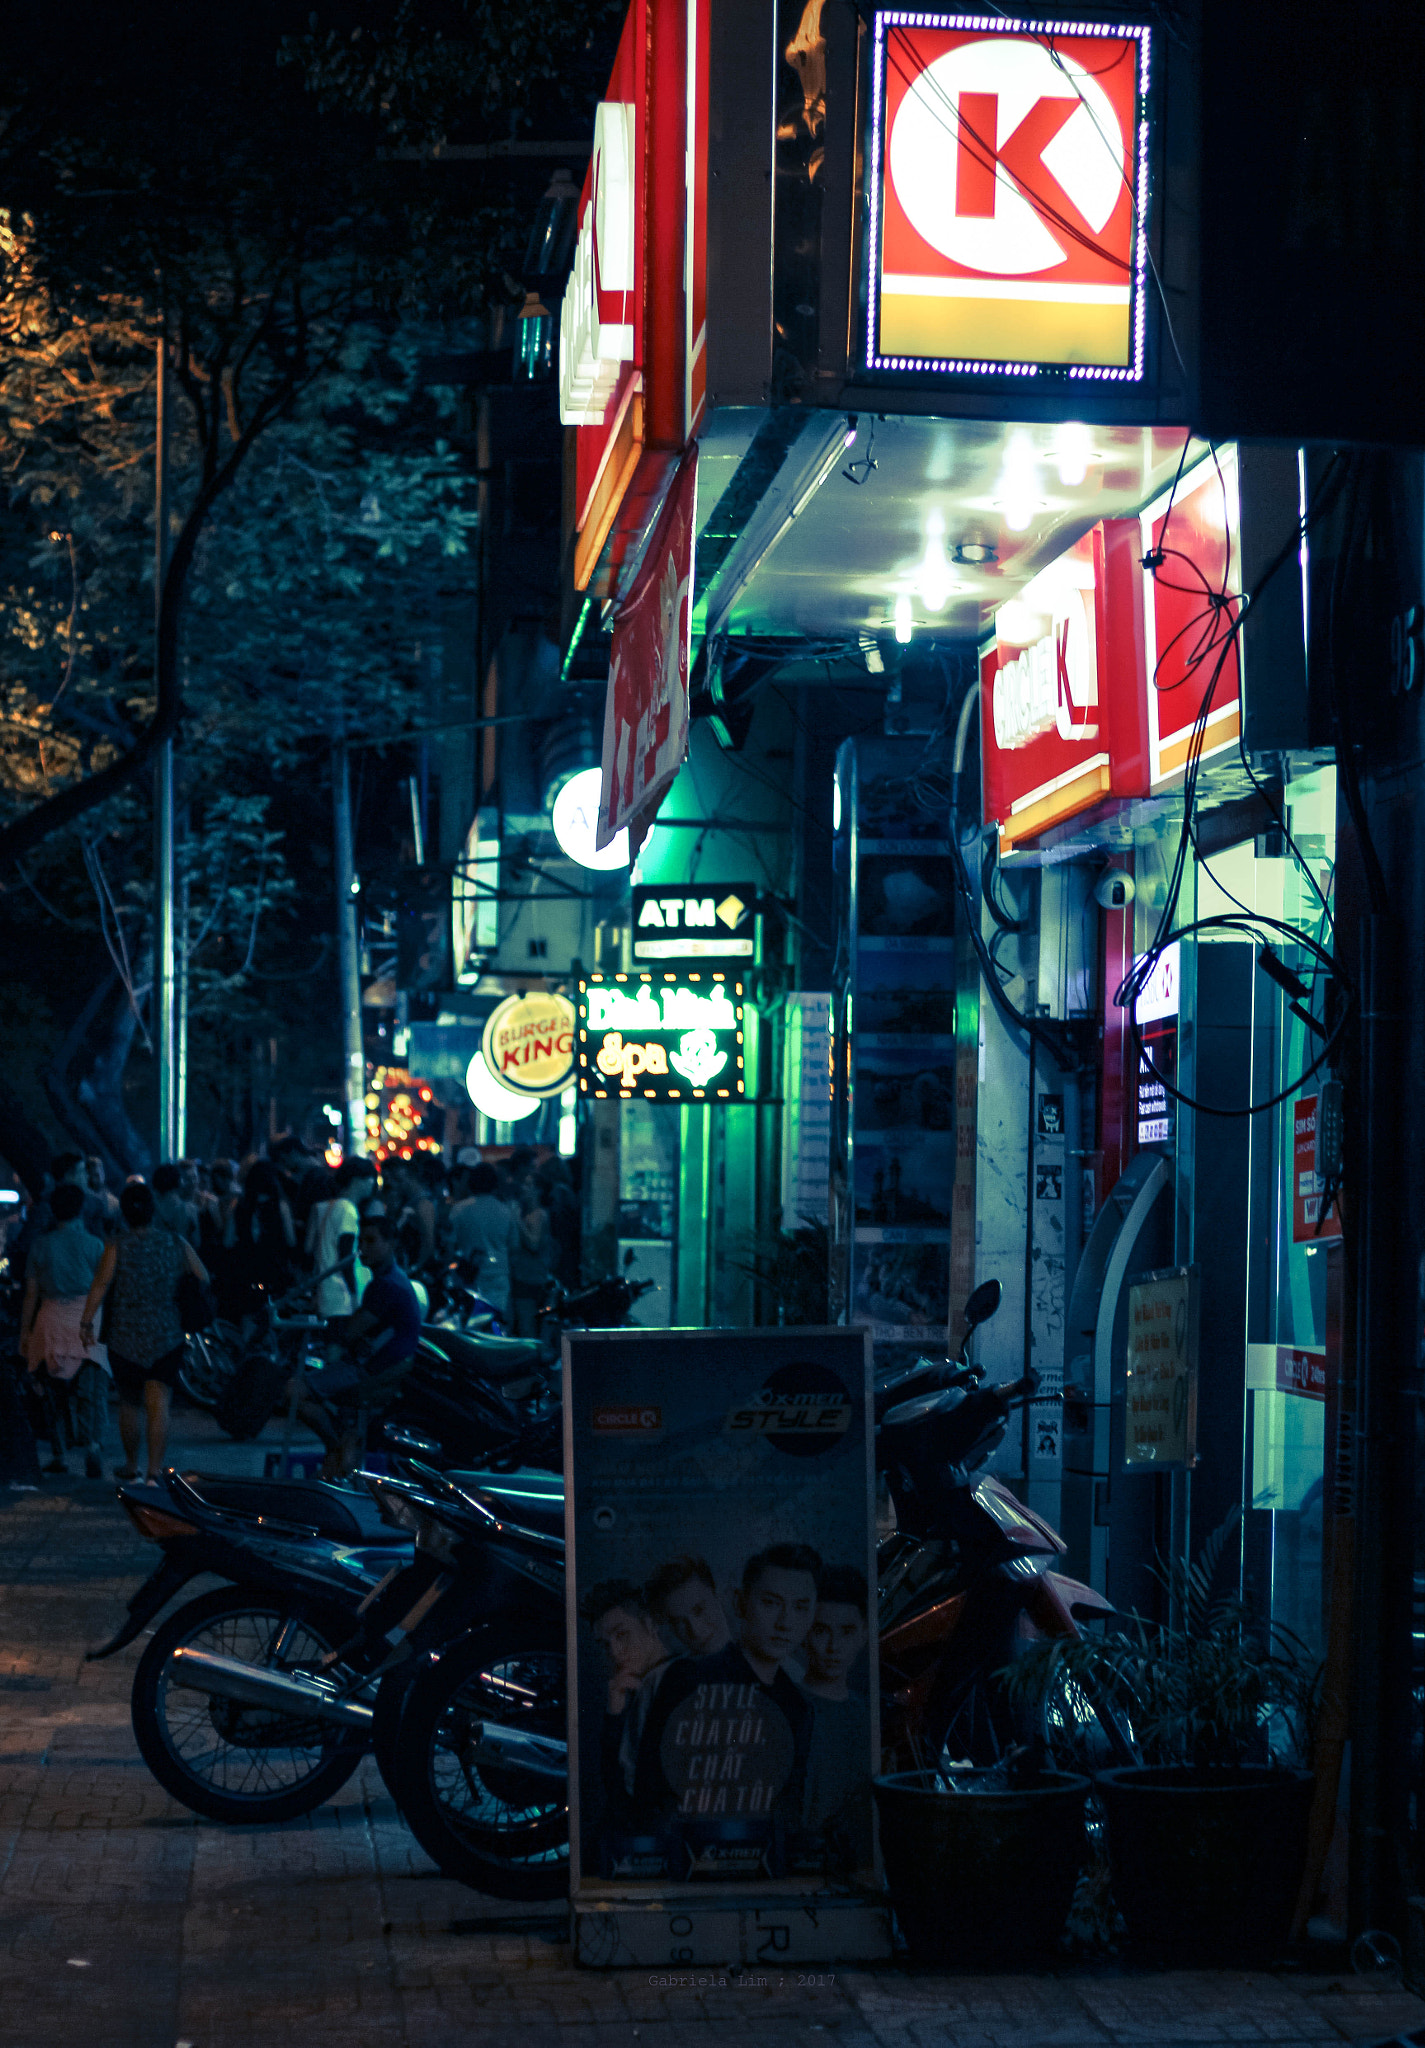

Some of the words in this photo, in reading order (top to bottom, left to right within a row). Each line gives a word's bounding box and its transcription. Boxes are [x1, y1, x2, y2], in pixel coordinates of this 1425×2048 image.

[638, 898, 716, 928] ATM
[500, 1016, 571, 1046] BURGER
[500, 1033, 574, 1074] KING
[597, 1031, 669, 1088] Spa
[597, 1413, 638, 1424] CIRCLE
[730, 1409, 843, 1429] STYLE
[694, 1684, 760, 1709] STYLE
